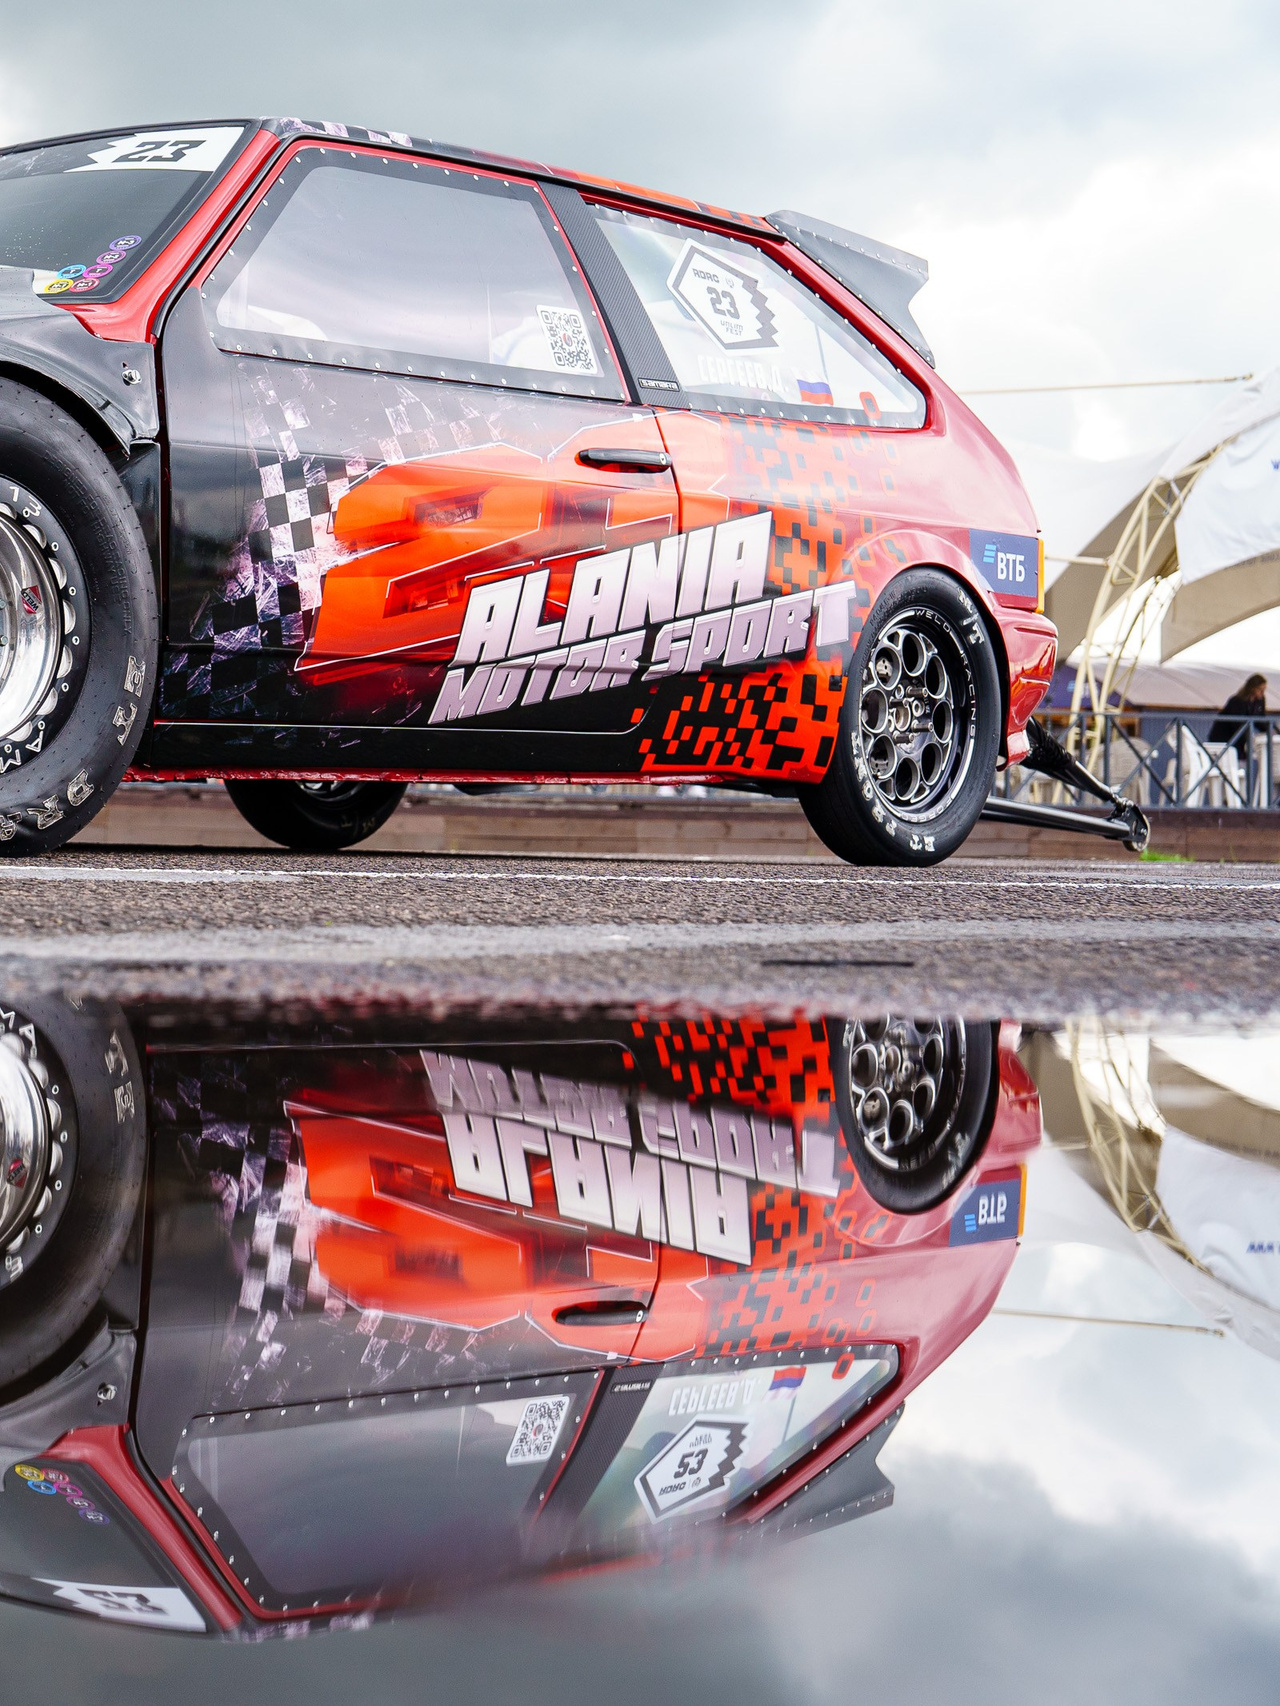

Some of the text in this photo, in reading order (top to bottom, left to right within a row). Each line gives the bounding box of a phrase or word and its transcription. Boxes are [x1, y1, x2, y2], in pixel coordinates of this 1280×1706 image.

[111, 140, 207, 162] 23
[692, 268, 719, 284] RDRC
[707, 287, 740, 320] 23
[725, 327, 742, 336] FEST
[997, 552, 1026, 582] ВТБ
[22, 591, 39, 611] WELD
[448, 511, 772, 667] ALANIA
[428, 630, 646, 725] MOTOR
[641, 580, 858, 681] SPORT
[914, 609, 951, 634] WELD
[960, 651, 976, 738] RACING
